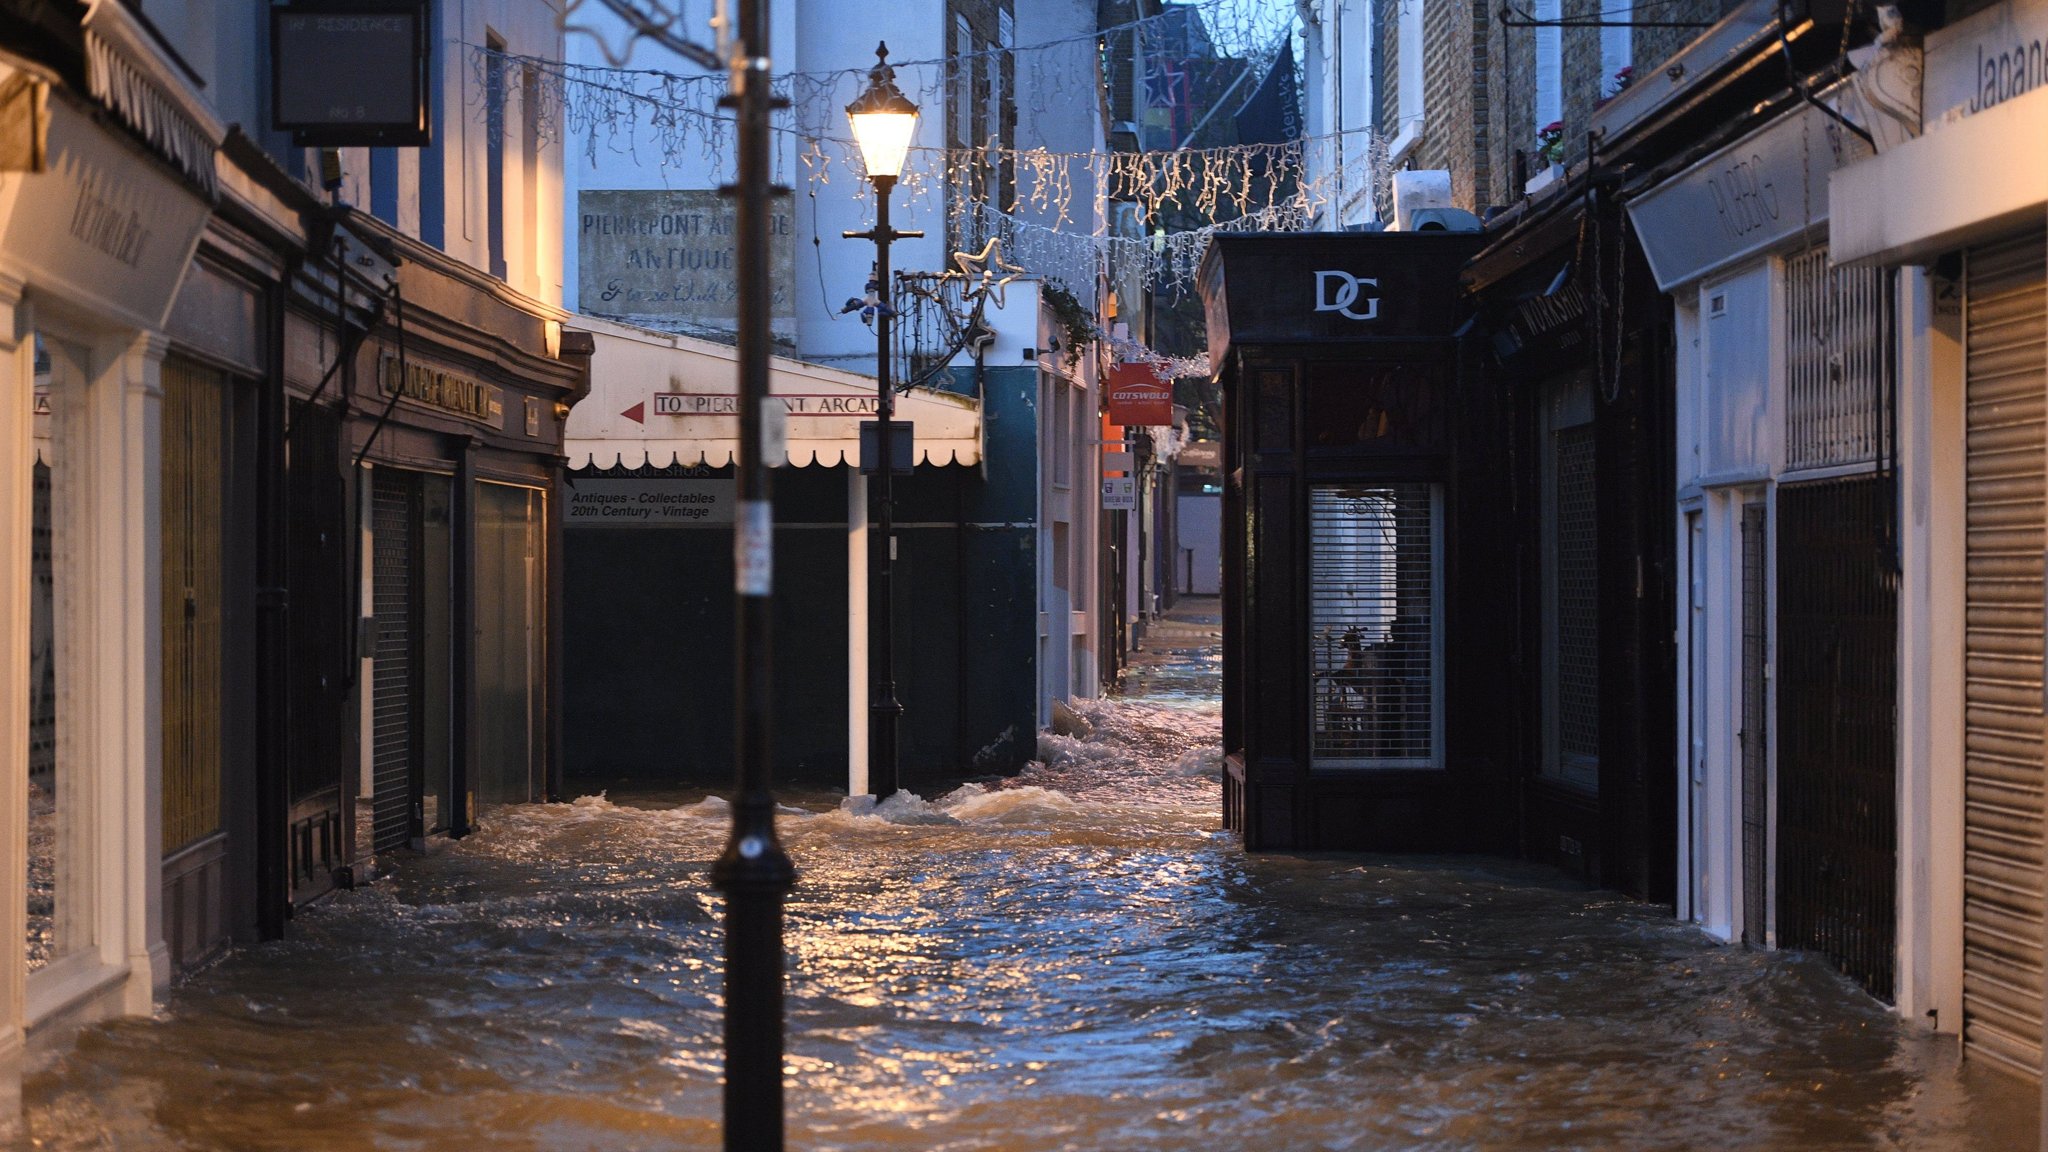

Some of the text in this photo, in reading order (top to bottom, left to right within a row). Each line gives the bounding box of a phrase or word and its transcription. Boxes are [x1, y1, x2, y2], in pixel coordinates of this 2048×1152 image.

[317, 17, 402, 32] RESIDENCE
[1313, 270, 1381, 321] DG
[1112, 391, 1169, 400] COTSWOLD
[657, 397, 681, 412] TO
[817, 398, 880, 413] ARCAD
[665, 465, 710, 477] SHOPS
[571, 492, 628, 505] Antiques
[638, 492, 716, 504] Collectables
[571, 505, 598, 517] 20th
[602, 505, 651, 519] Century
[662, 505, 709, 519] Vintage
